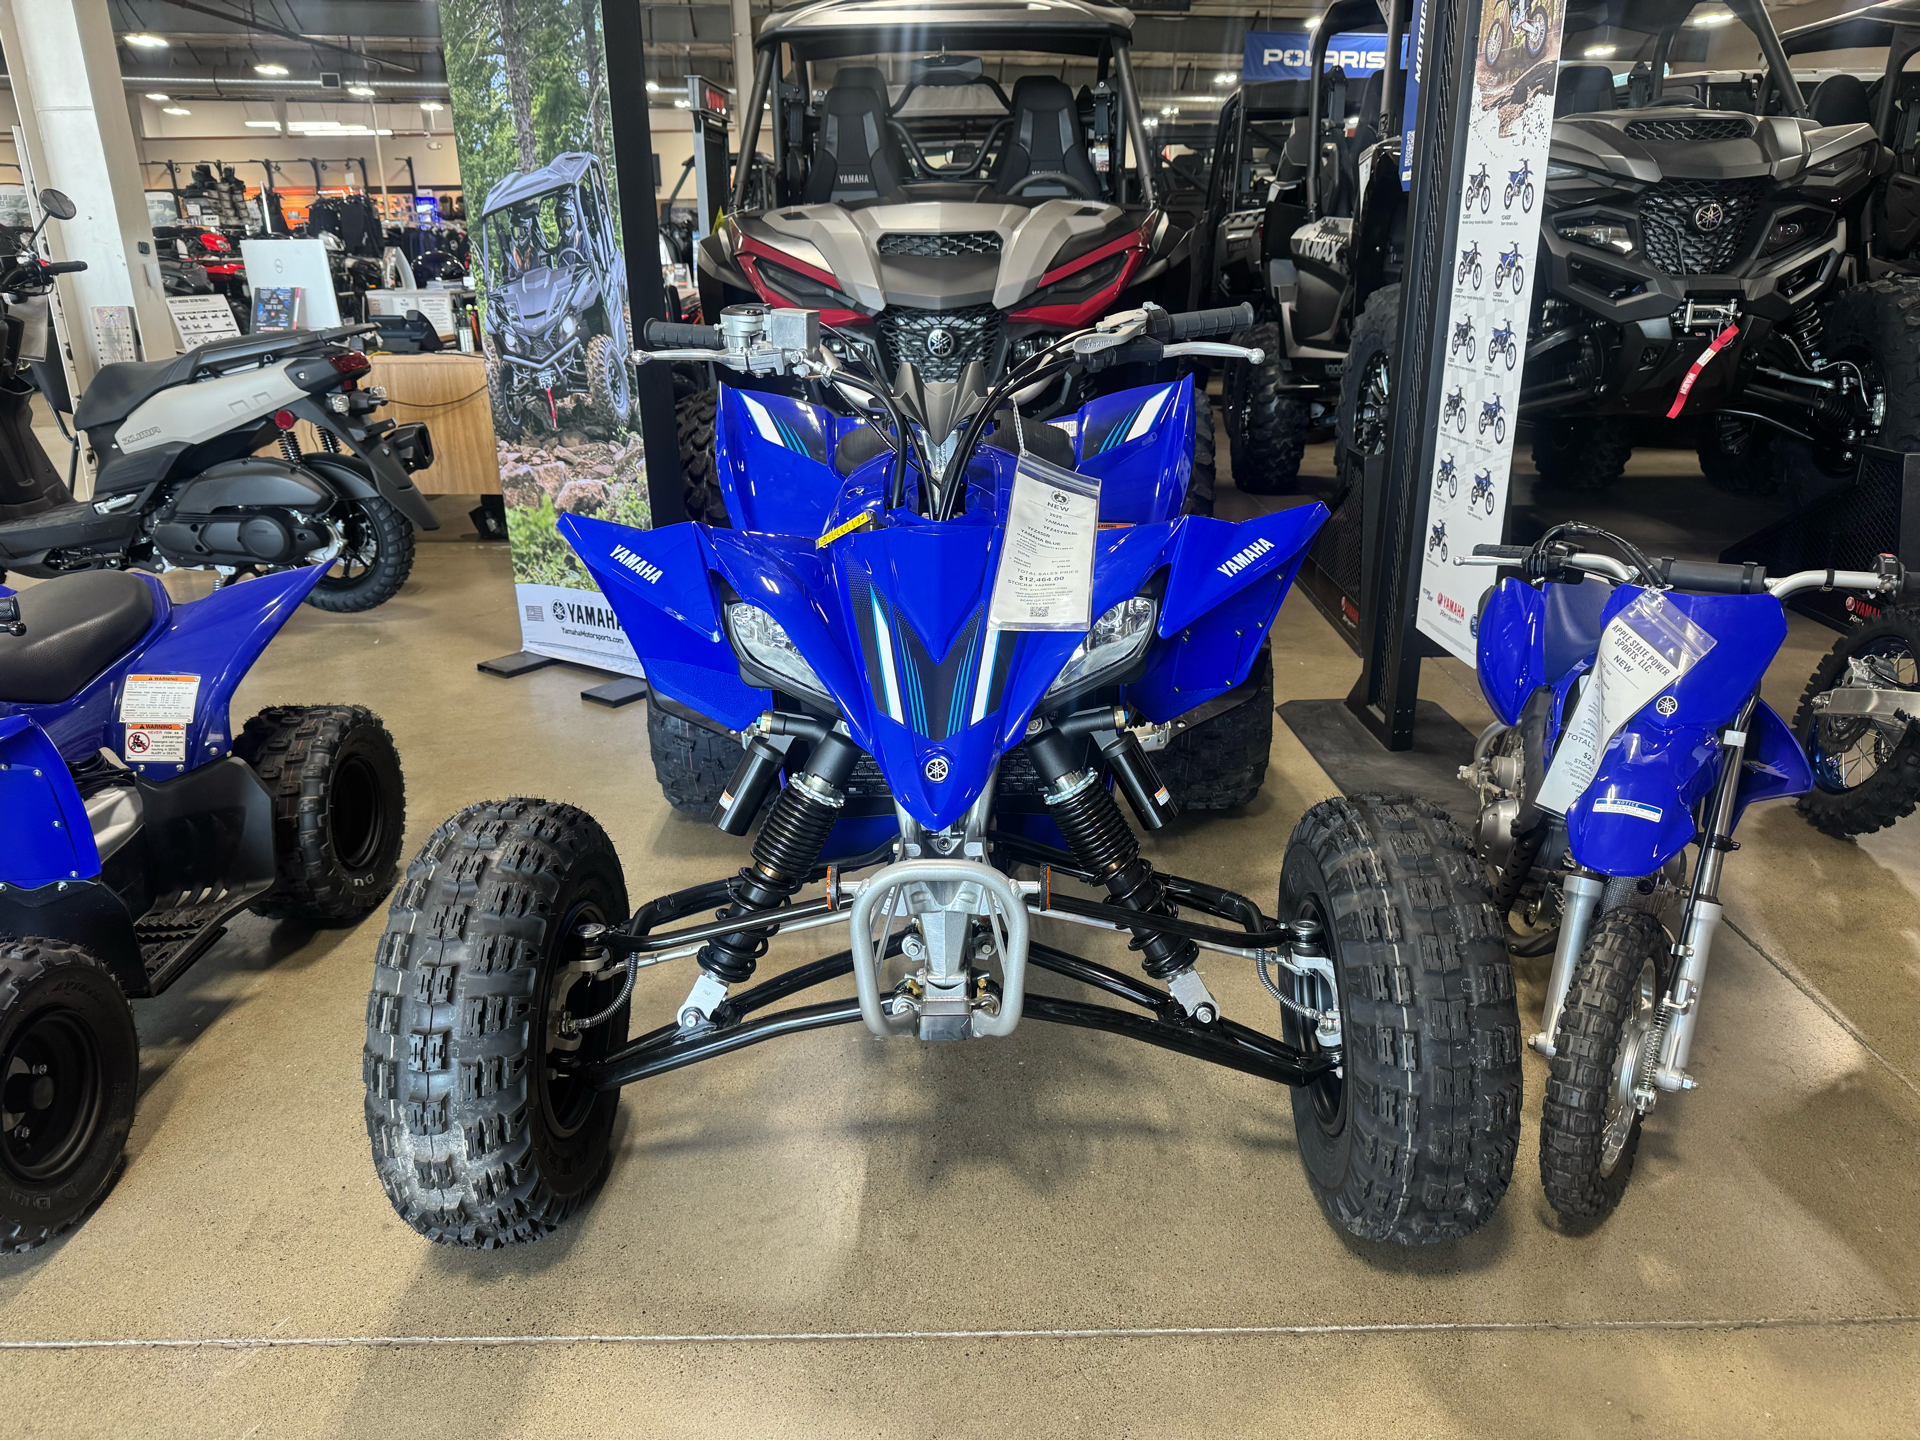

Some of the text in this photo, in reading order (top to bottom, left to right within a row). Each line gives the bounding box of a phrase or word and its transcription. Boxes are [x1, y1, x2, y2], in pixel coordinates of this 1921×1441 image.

[839, 174, 869, 184] YAMAHA
[122, 426, 161, 445] ZUMA
[1047, 501, 1070, 512] NEW
[1044, 518, 1070, 529] YAMAHA
[1020, 528, 1044, 543] YAMAHA
[1045, 539, 1061, 547] BLUE
[610, 544, 663, 585] YAMAHA
[1216, 537, 1275, 578] YAMAHA
[1017, 568, 1037, 576] TOTAL
[1443, 595, 1465, 620] YAMAHA
[1611, 624, 1670, 677] APPLE STATE POWER
[1614, 637, 1652, 674] SPORTS, LLC.
[1613, 655, 1634, 673] NEW
[1567, 731, 1592, 748] TOTAL
